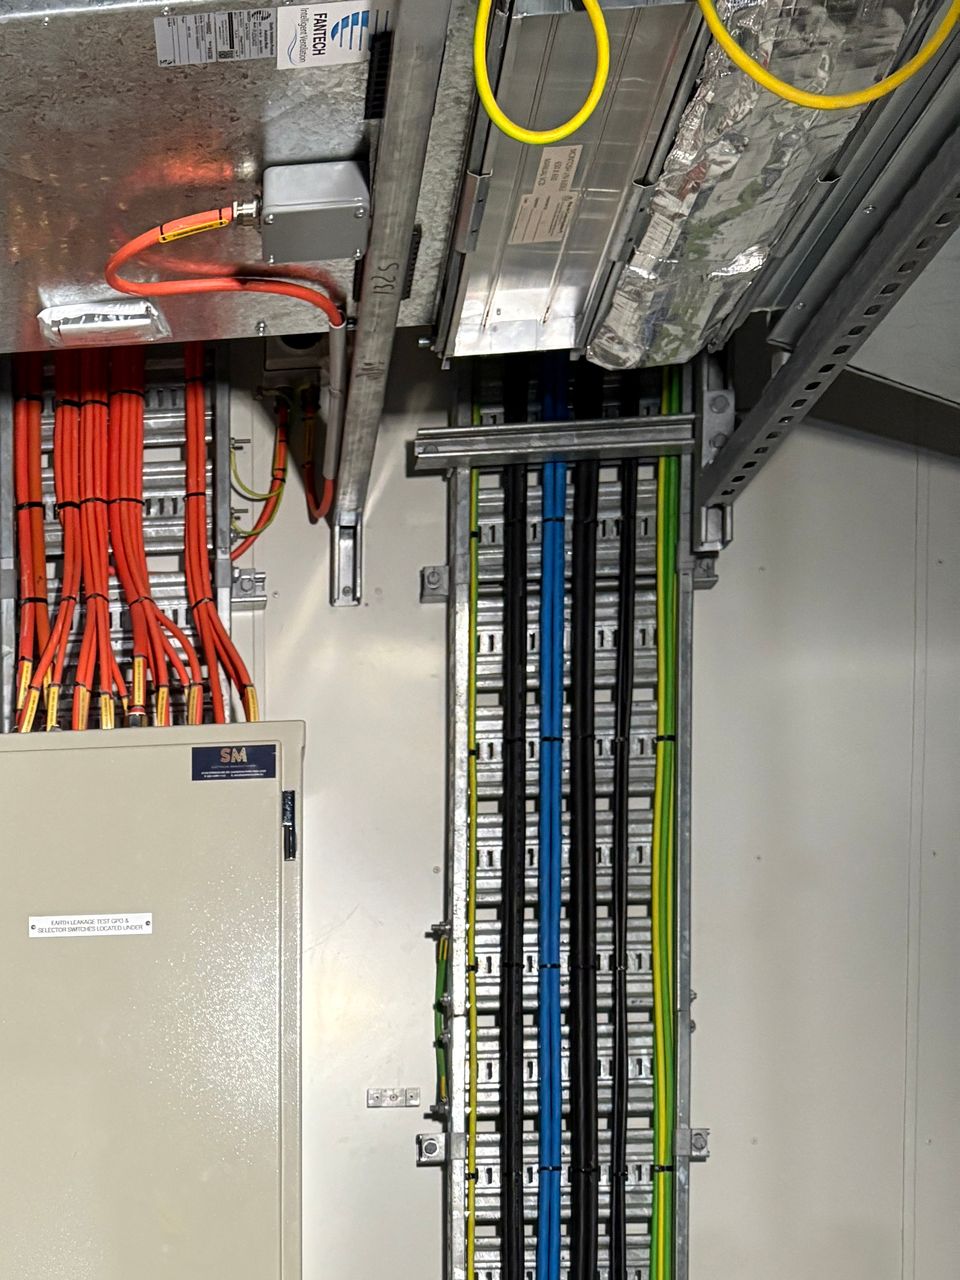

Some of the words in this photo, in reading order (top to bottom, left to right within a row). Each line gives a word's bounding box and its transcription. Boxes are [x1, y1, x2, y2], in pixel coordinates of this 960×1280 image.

[298, 7, 309, 35] Intelligent
[312, 13, 327, 56] FANTECH
[299, 34, 308, 63] Ventilation
[220, 746, 248, 763] SM
